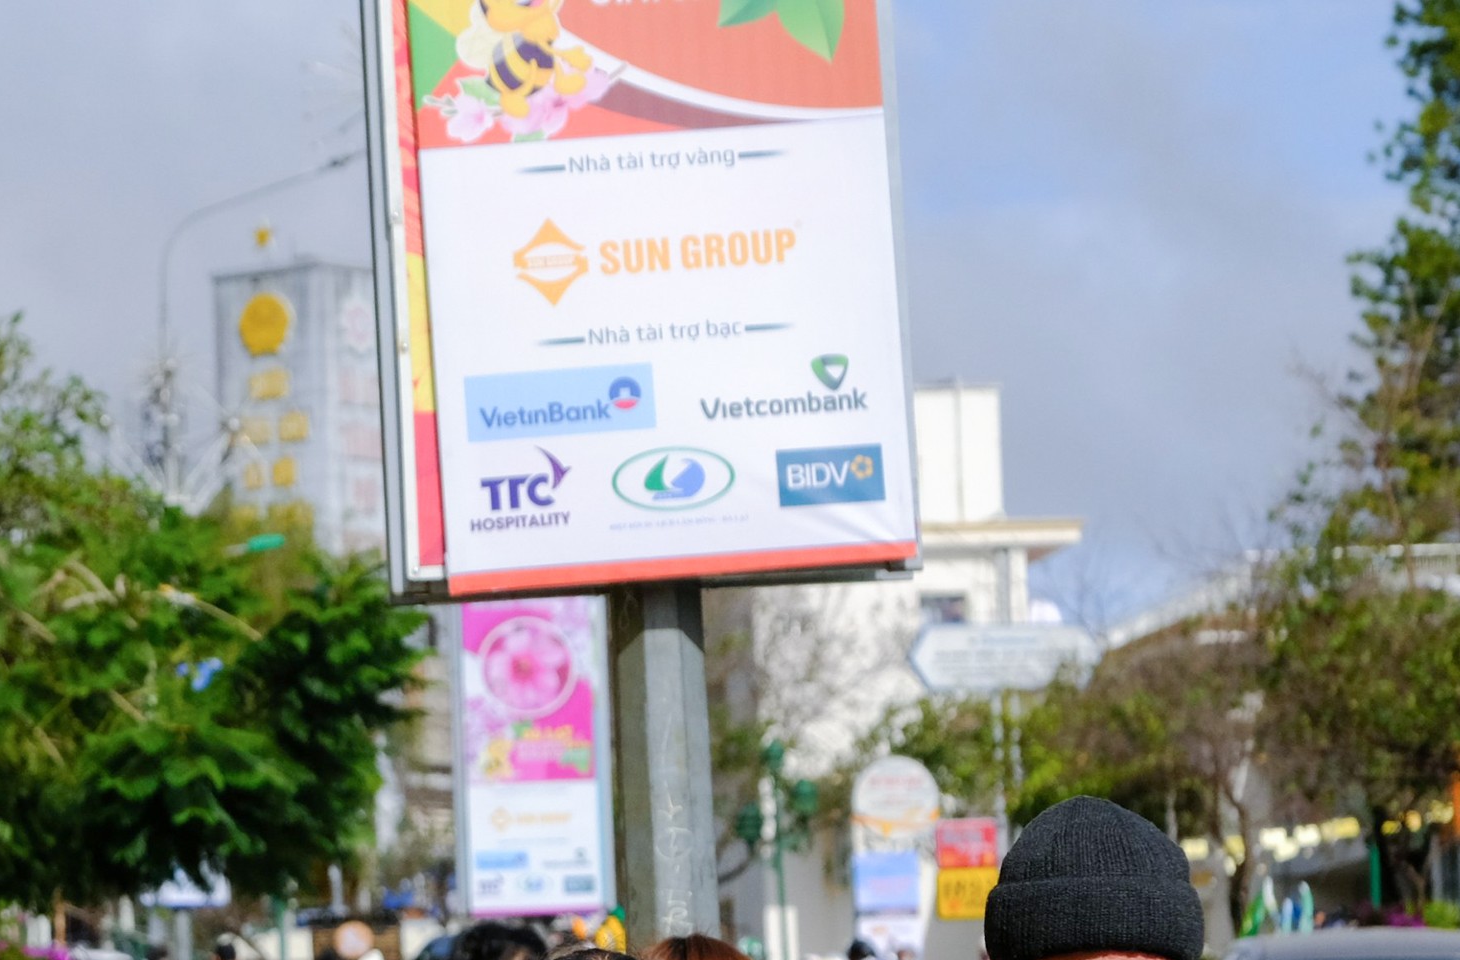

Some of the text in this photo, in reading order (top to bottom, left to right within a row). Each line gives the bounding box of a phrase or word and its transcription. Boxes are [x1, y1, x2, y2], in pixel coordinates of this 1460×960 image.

[568, 147, 736, 173] Nhà tài trợ vàng
[599, 228, 797, 276] SUN GROUP
[587, 319, 742, 345] Nhà tài trợ bạc
[479, 398, 611, 429] VietinBank
[699, 387, 868, 420] Vietcombank
[786, 460, 851, 491] BIDV
[480, 473, 555, 511] TTC
[470, 511, 571, 532] HOSPITALITY
